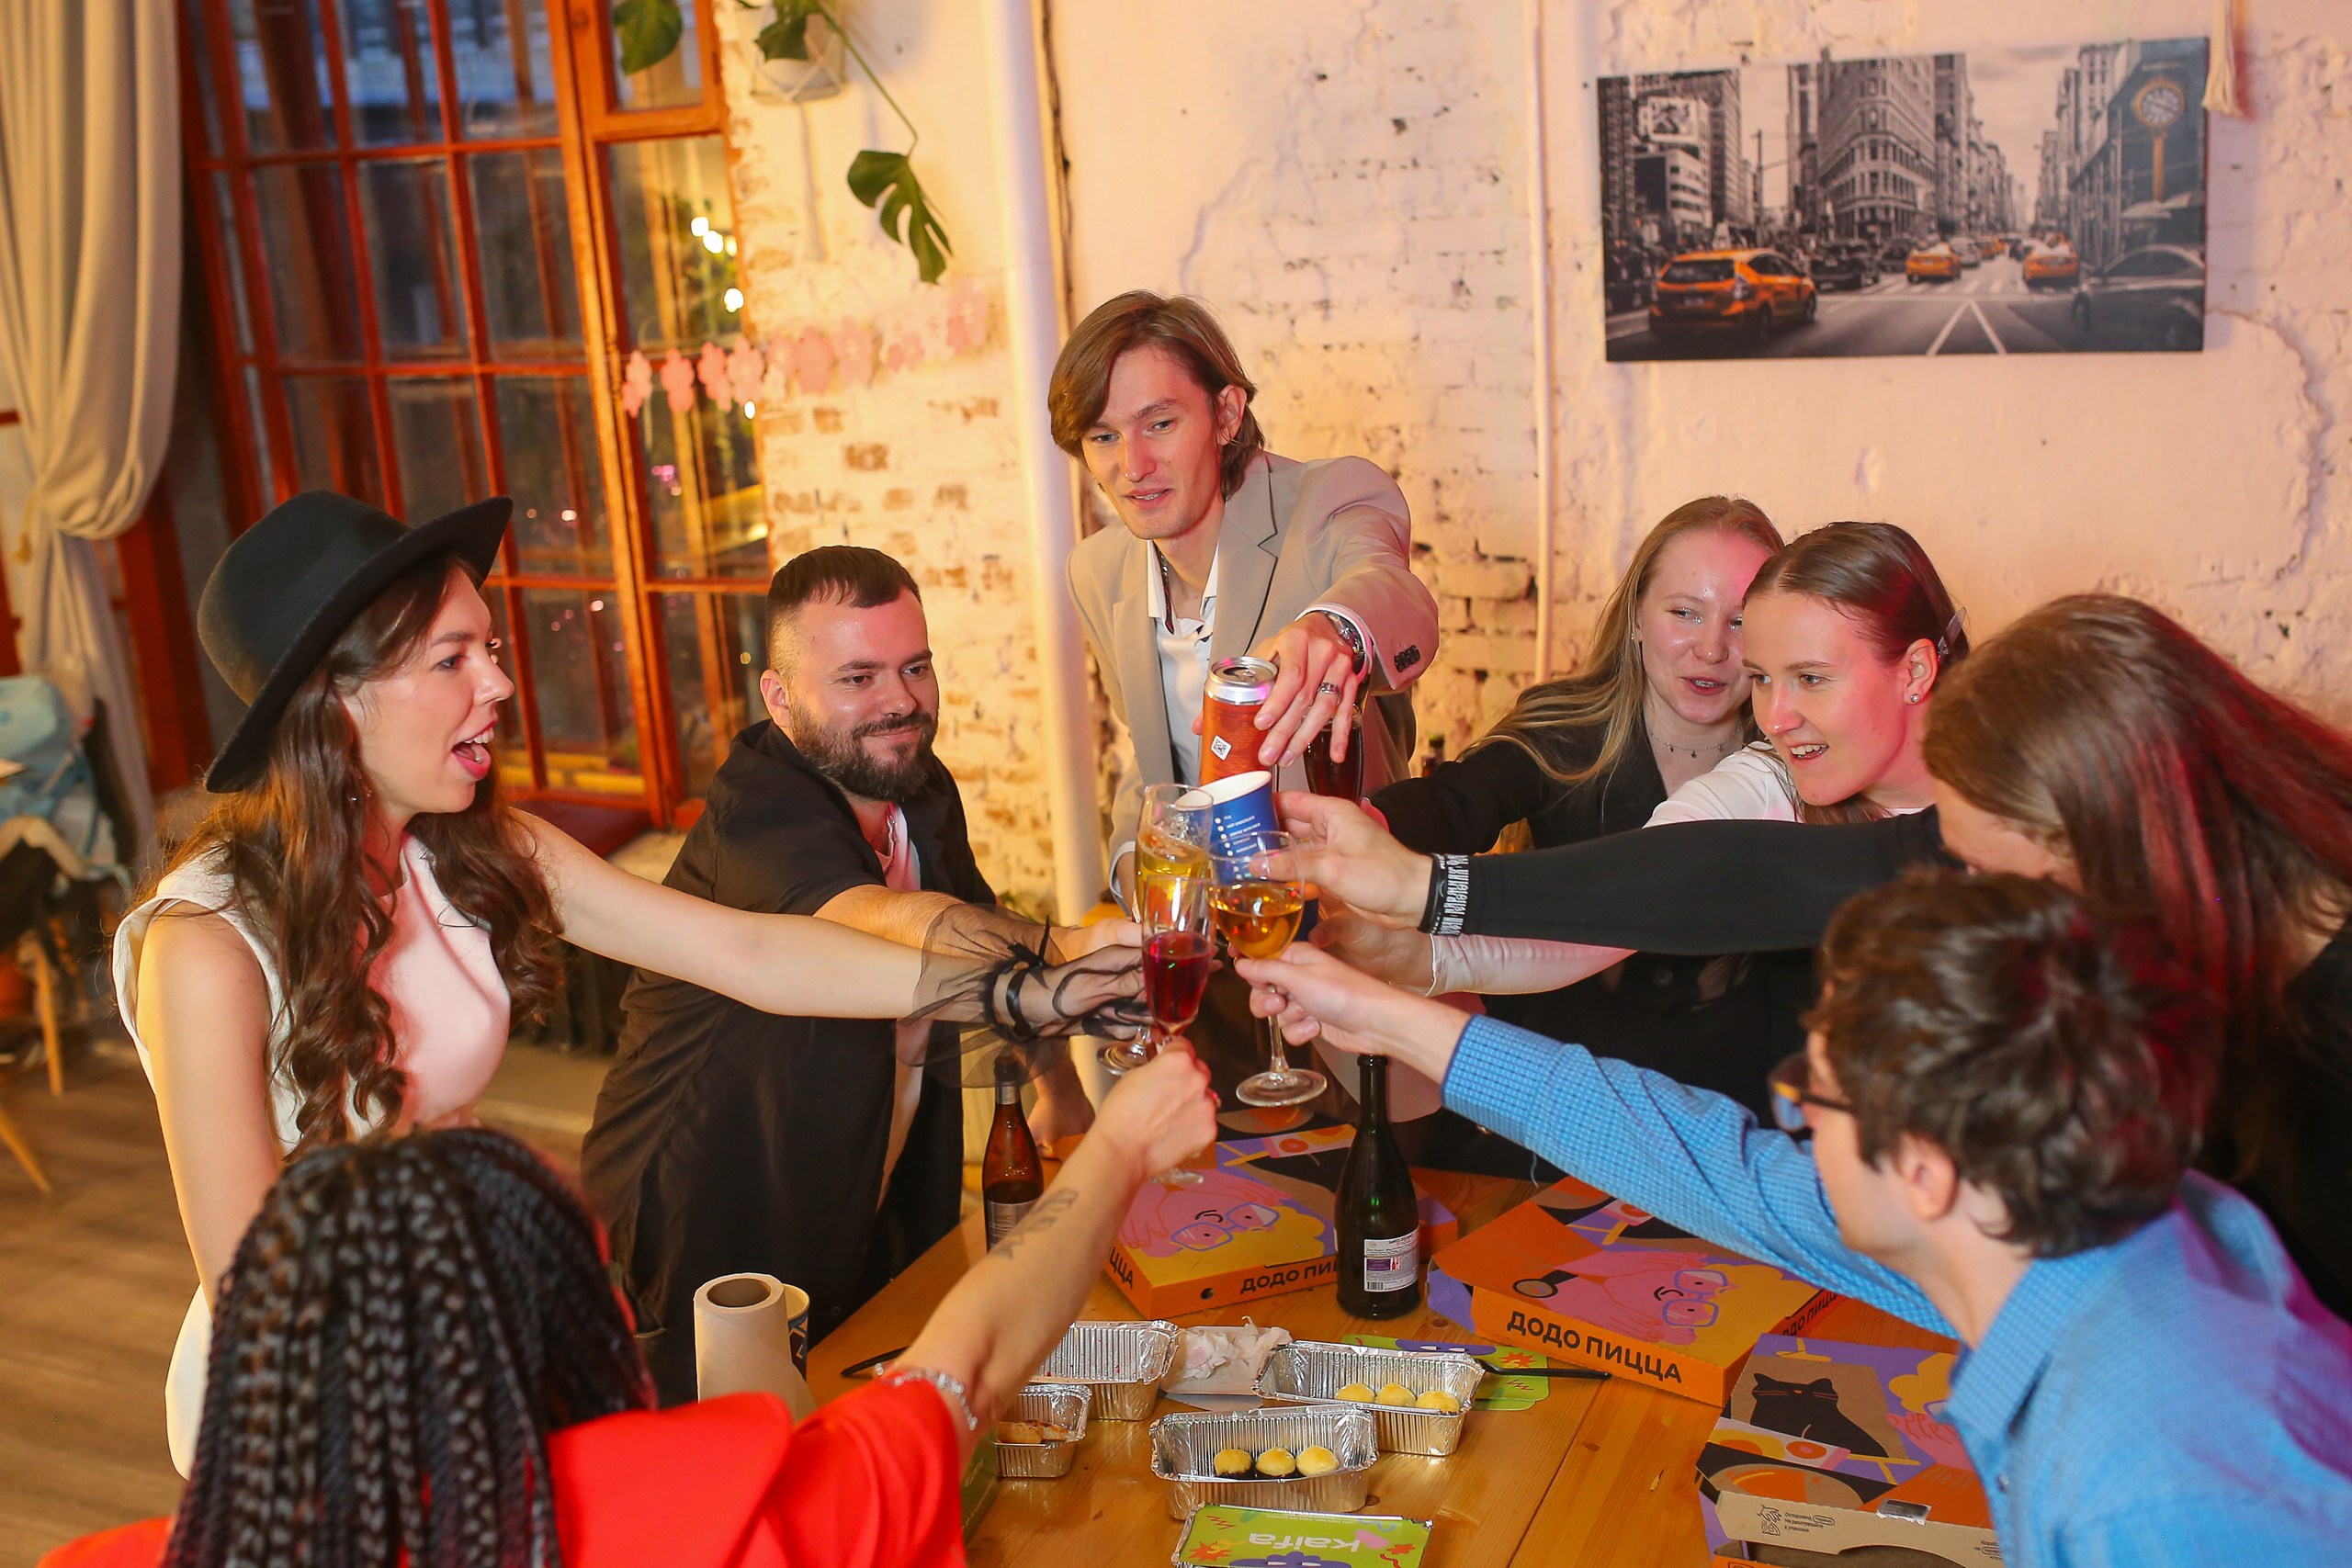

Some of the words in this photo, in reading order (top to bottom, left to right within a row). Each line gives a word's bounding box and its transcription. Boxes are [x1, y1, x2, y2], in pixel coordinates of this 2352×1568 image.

[1240, 1269, 1300, 1295] ДОДО
[1304, 1260, 1338, 1280] ПИ
[1506, 1310, 1581, 1349] ДОДО
[1586, 1336, 1682, 1383] ПИЦЦА
[1249, 1532, 1361, 1552] kaifa
